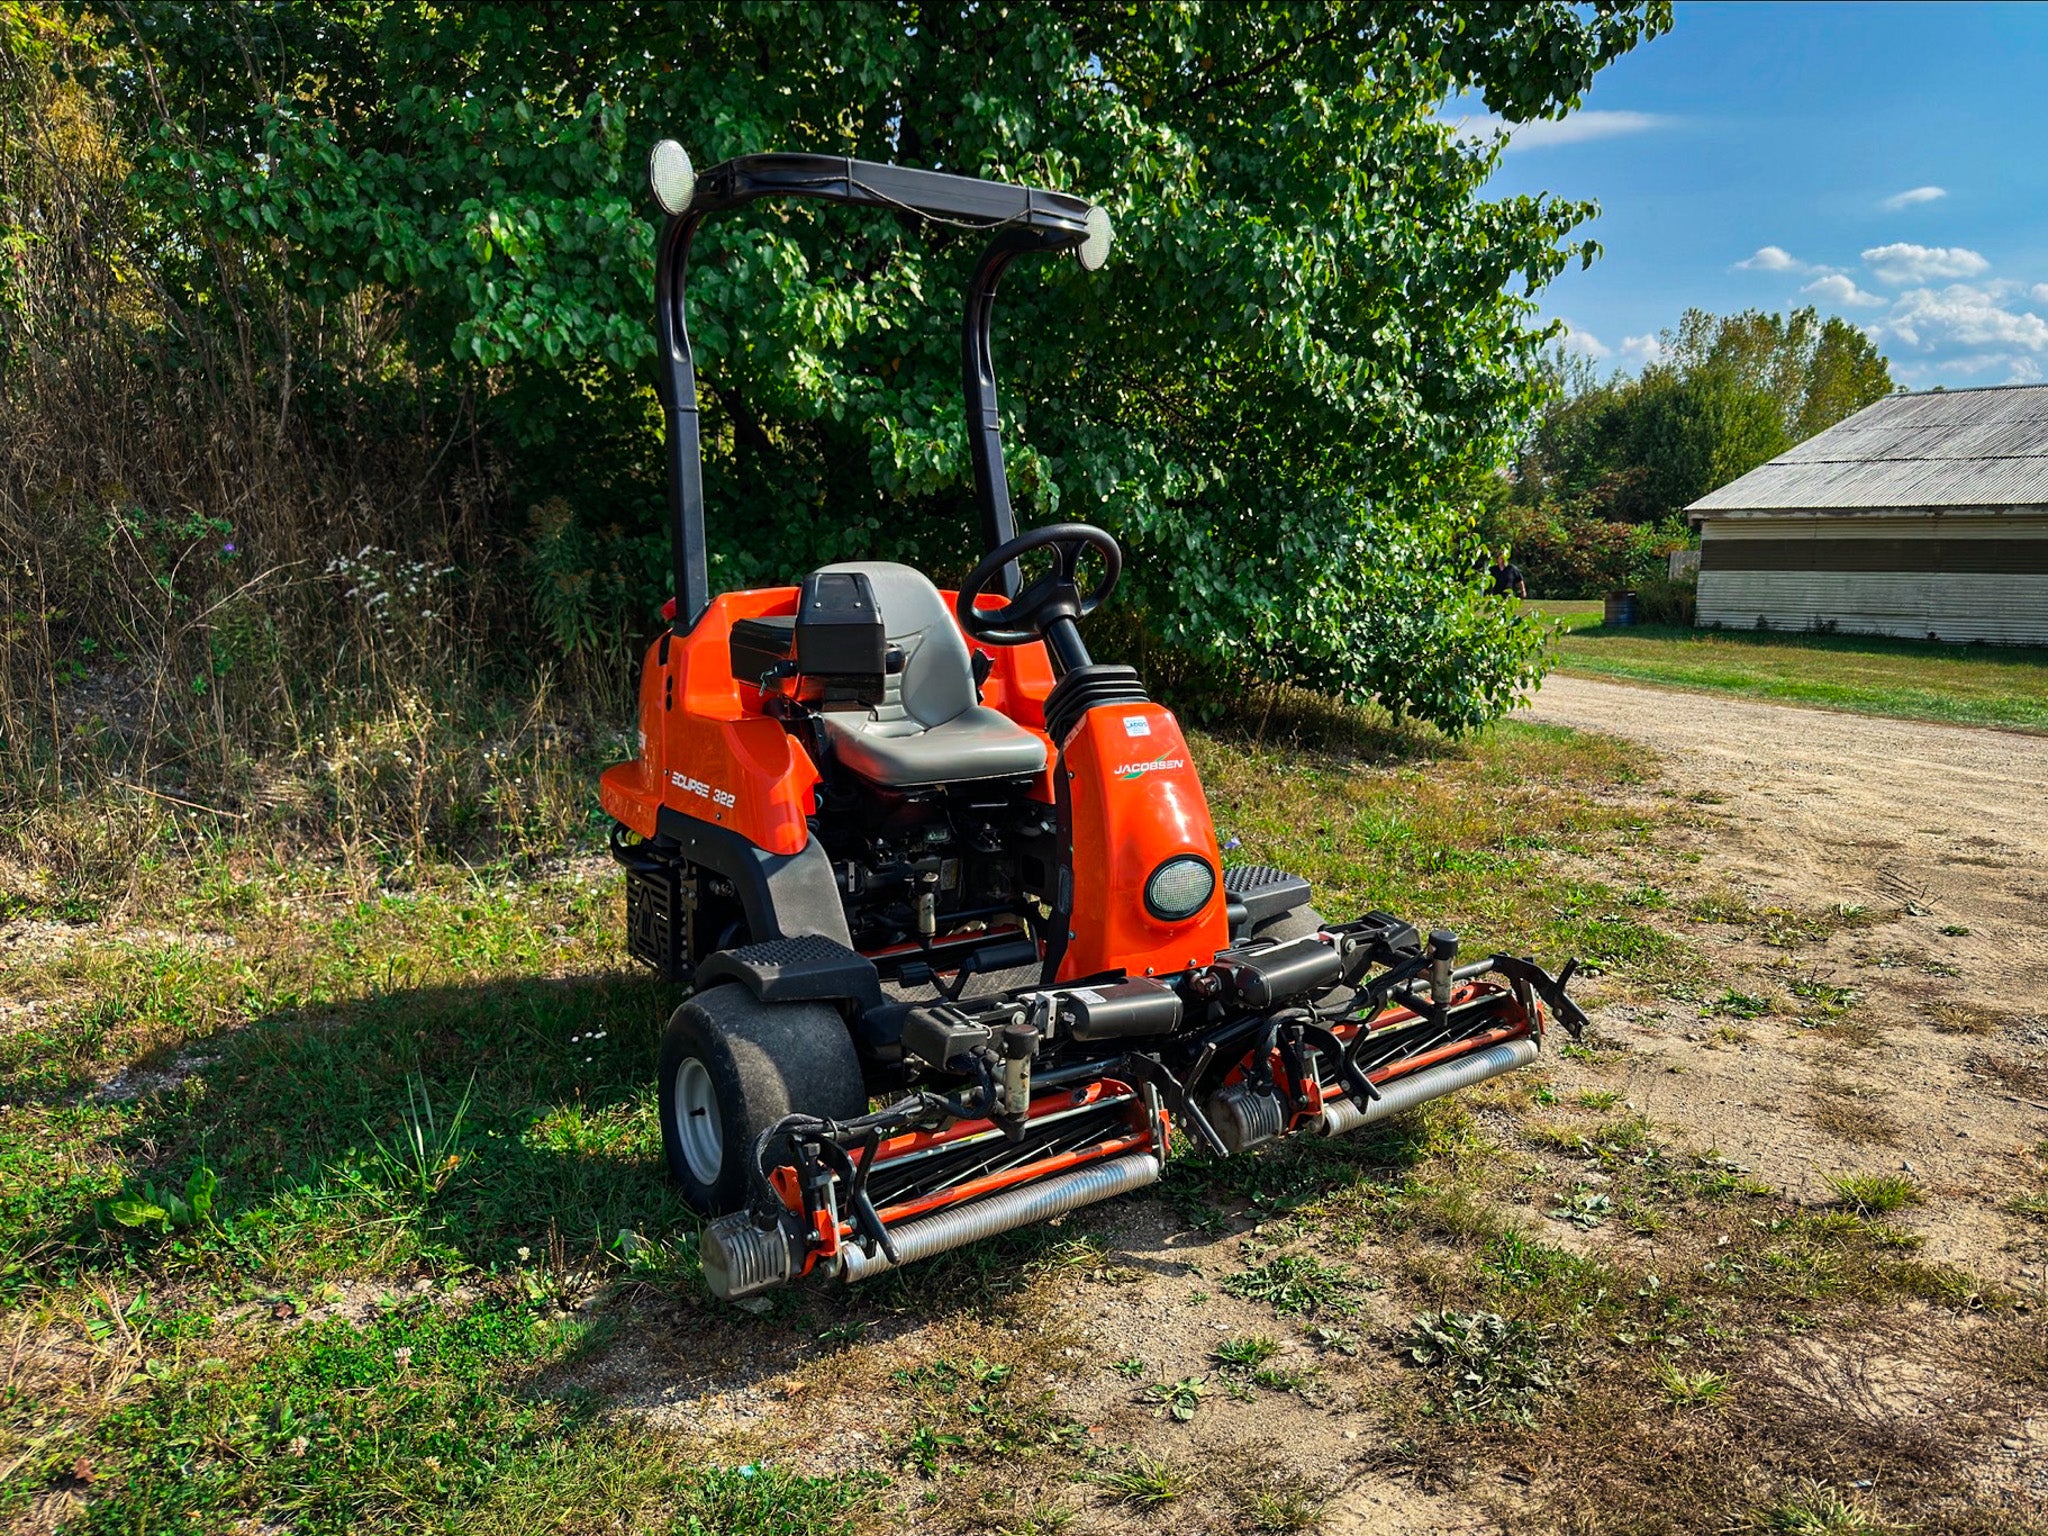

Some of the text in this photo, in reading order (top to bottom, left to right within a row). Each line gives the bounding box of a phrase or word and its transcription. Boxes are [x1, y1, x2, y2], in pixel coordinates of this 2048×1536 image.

[1113, 759, 1184, 775] JACOBSEN
[671, 771, 736, 809] ECLIPSE 322
